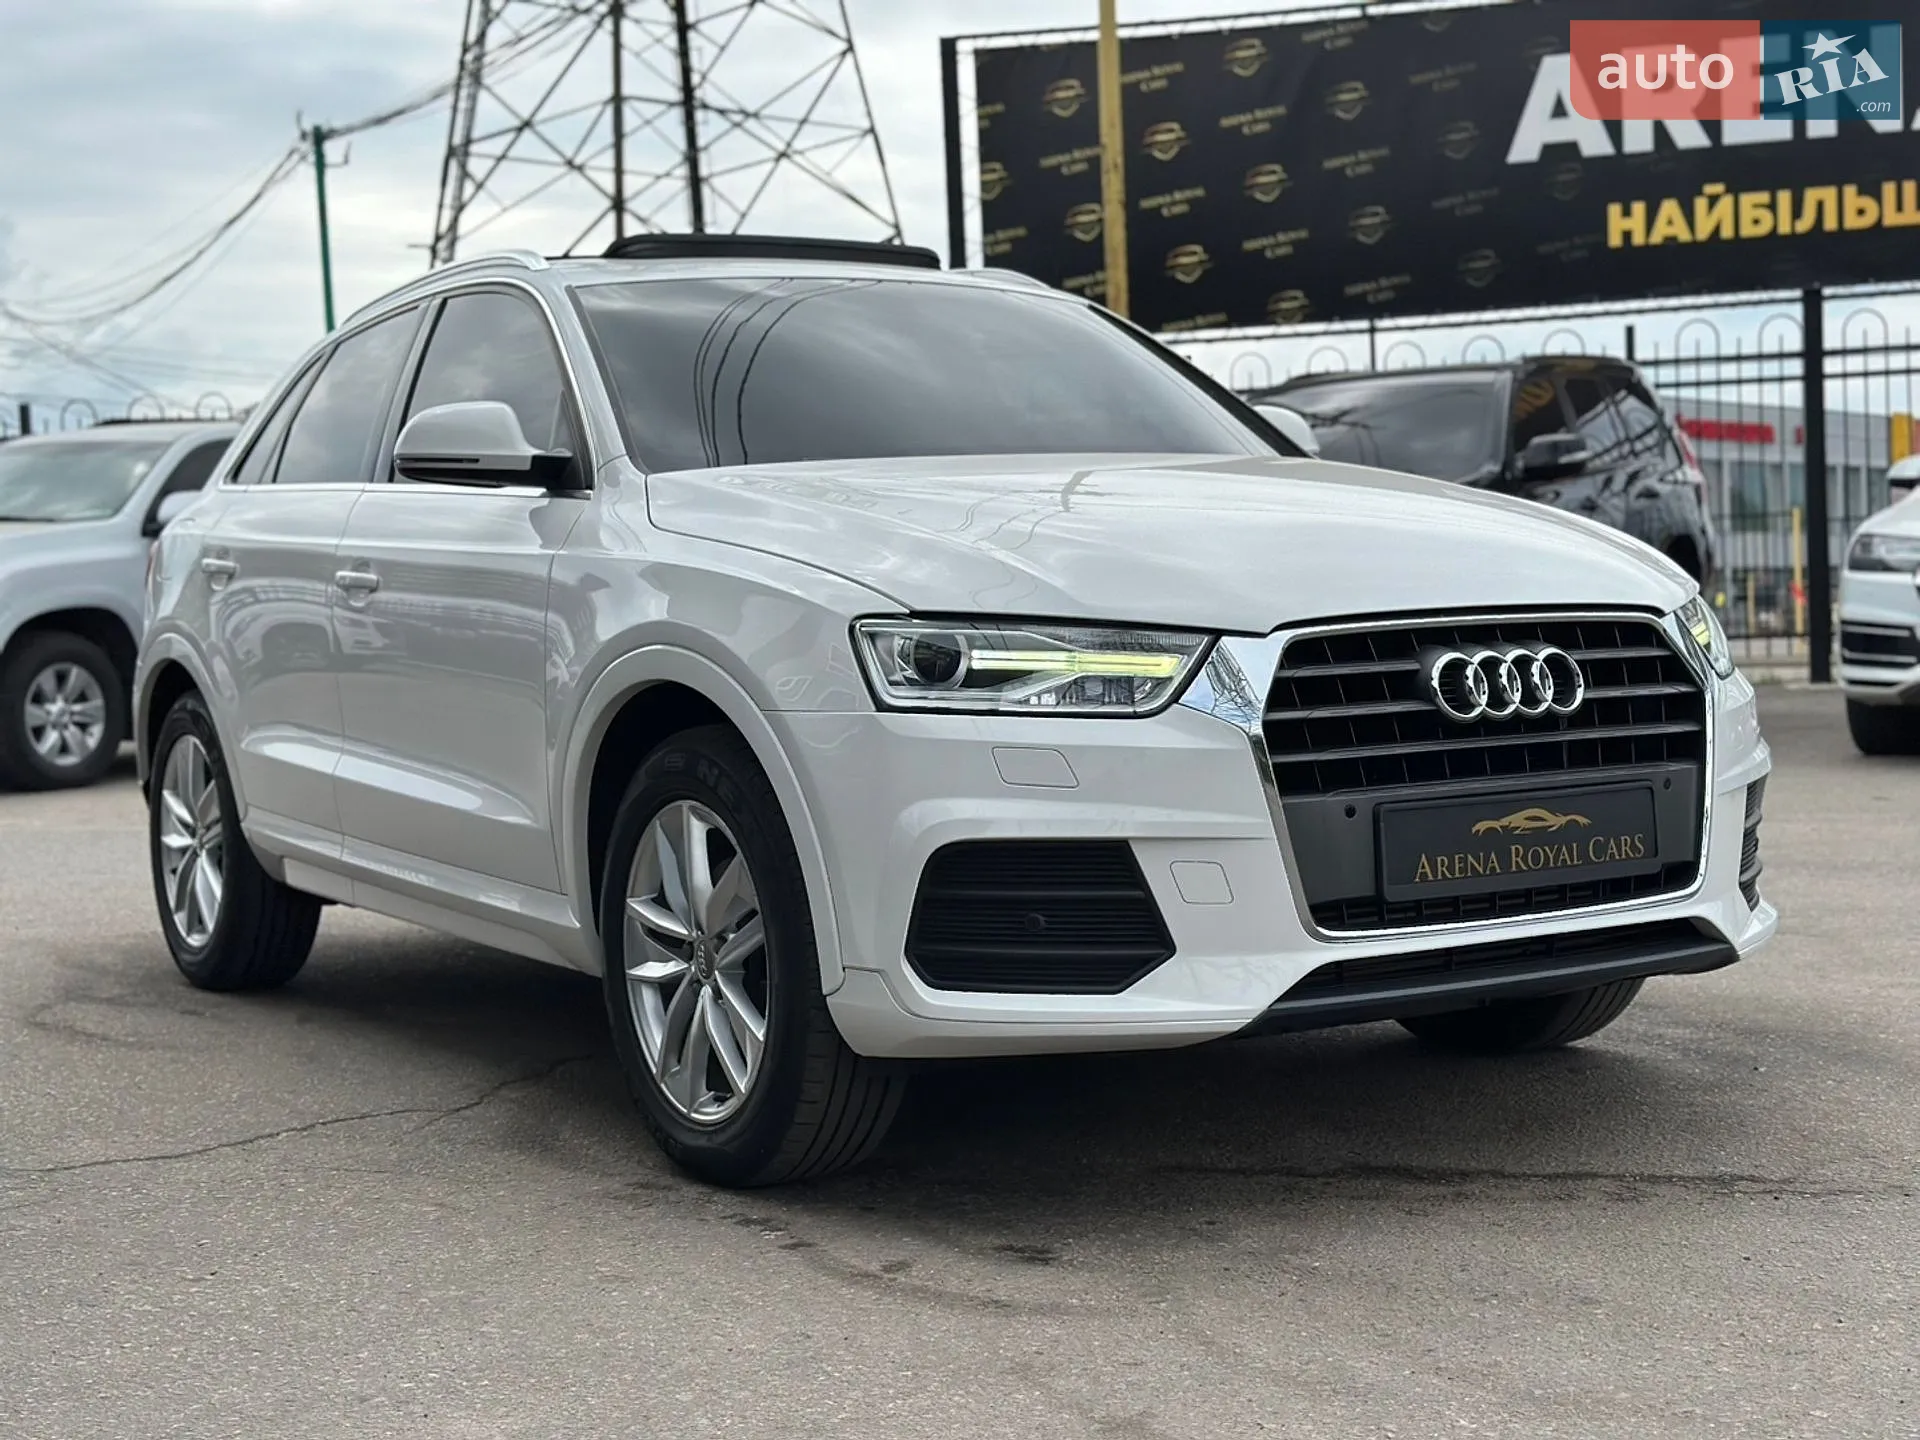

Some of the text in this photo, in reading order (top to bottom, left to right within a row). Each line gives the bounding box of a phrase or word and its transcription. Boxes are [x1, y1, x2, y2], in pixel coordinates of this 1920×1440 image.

[1504, 23, 1920, 165] AREN
[1413, 833, 1645, 883] ARENA ROYAL CARS
